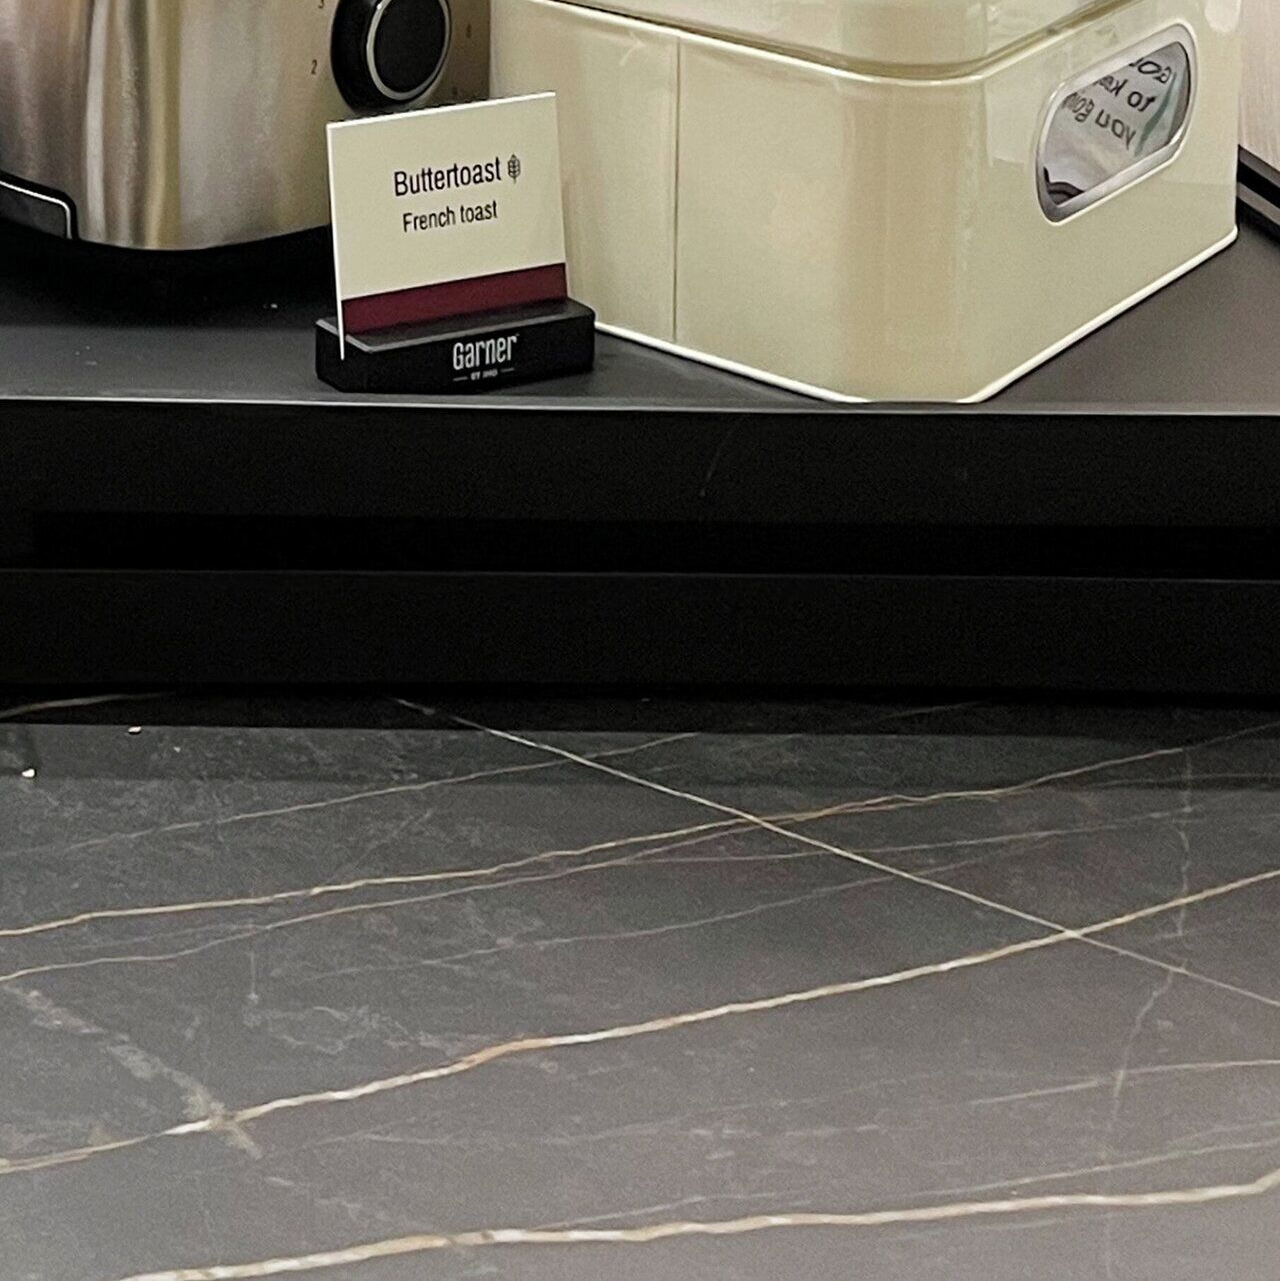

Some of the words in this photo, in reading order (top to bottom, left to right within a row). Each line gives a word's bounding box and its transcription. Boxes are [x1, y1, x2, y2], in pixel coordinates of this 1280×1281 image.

[310, 59, 318, 75] 2
[393, 157, 502, 197] Buttertoast
[402, 206, 457, 233] French
[460, 199, 499, 224] toast
[453, 335, 518, 371] Garner
